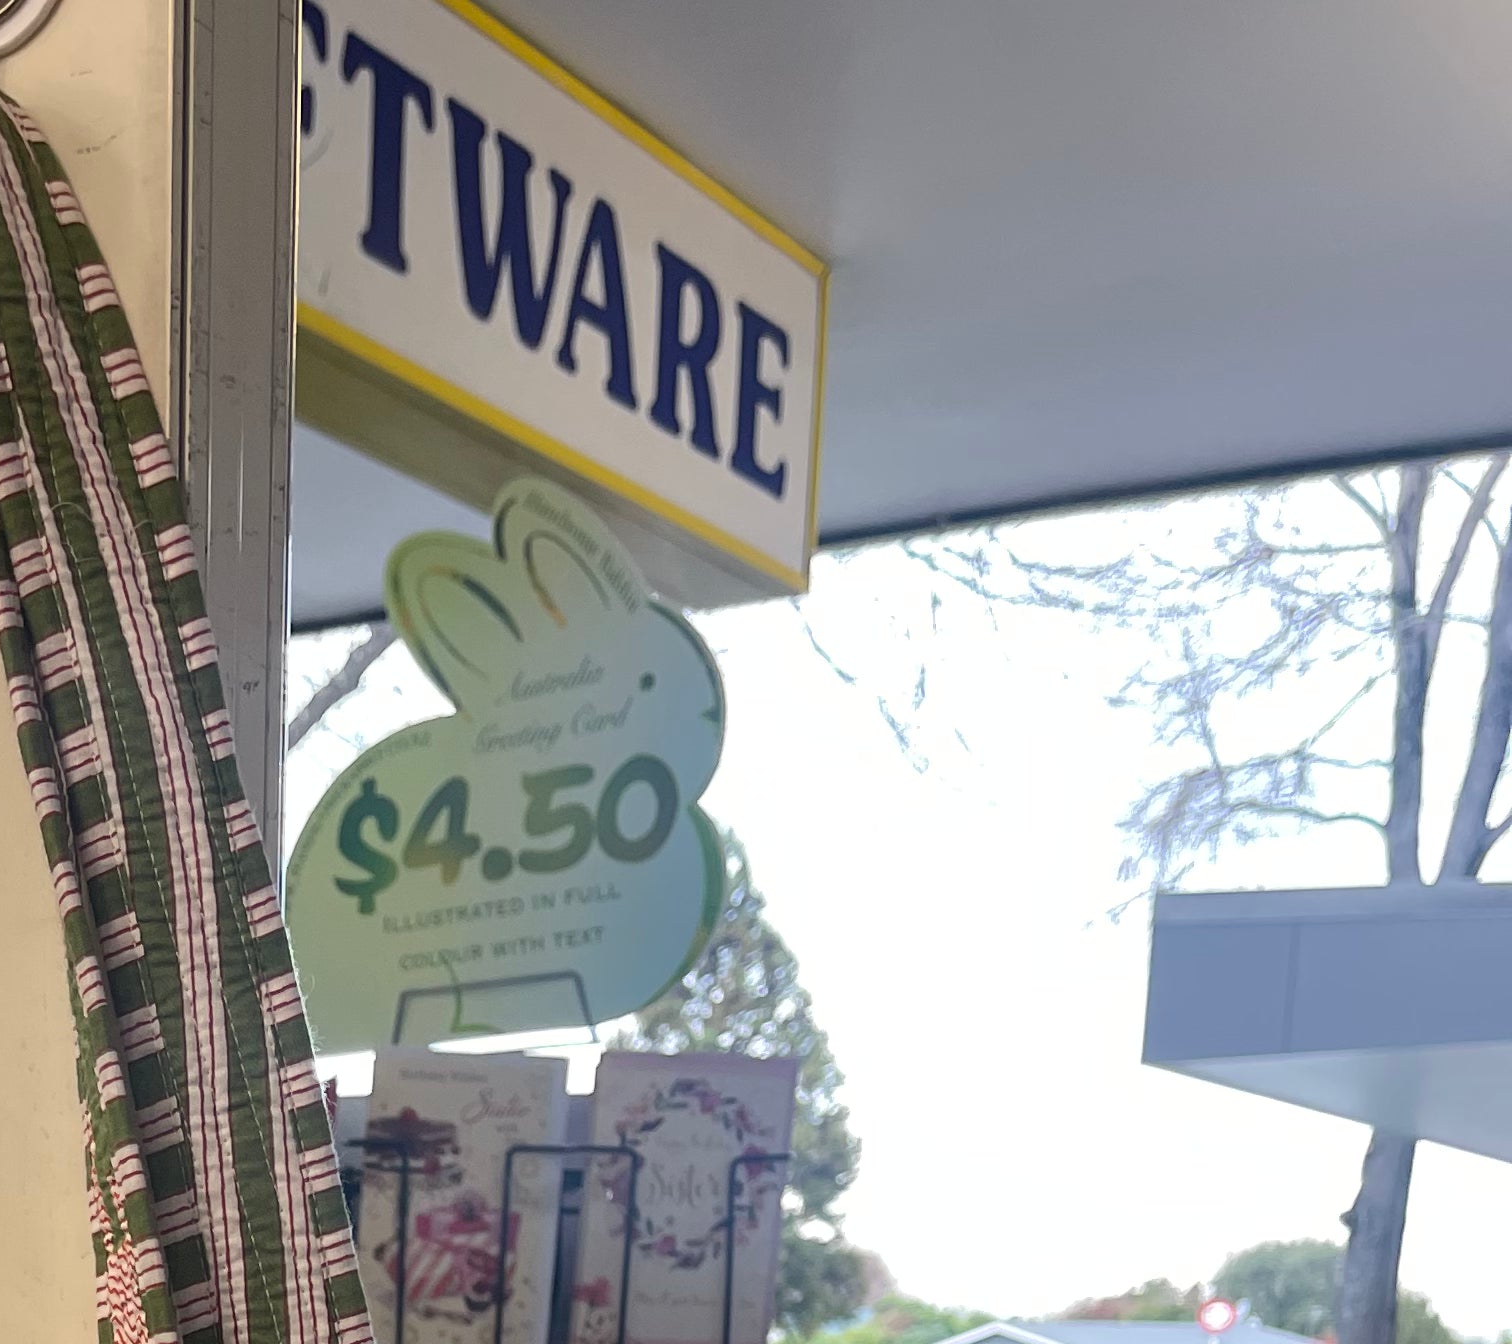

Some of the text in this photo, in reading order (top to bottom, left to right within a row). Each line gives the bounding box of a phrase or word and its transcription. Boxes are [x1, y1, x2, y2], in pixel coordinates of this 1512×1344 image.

[301, 0, 789, 500] TWARE
[334, 752, 681, 915] $4.50
[398, 925, 605, 971] COLOUR WITH TEXT
[531, 892, 556, 911] IN
[563, 882, 622, 906] FULL
